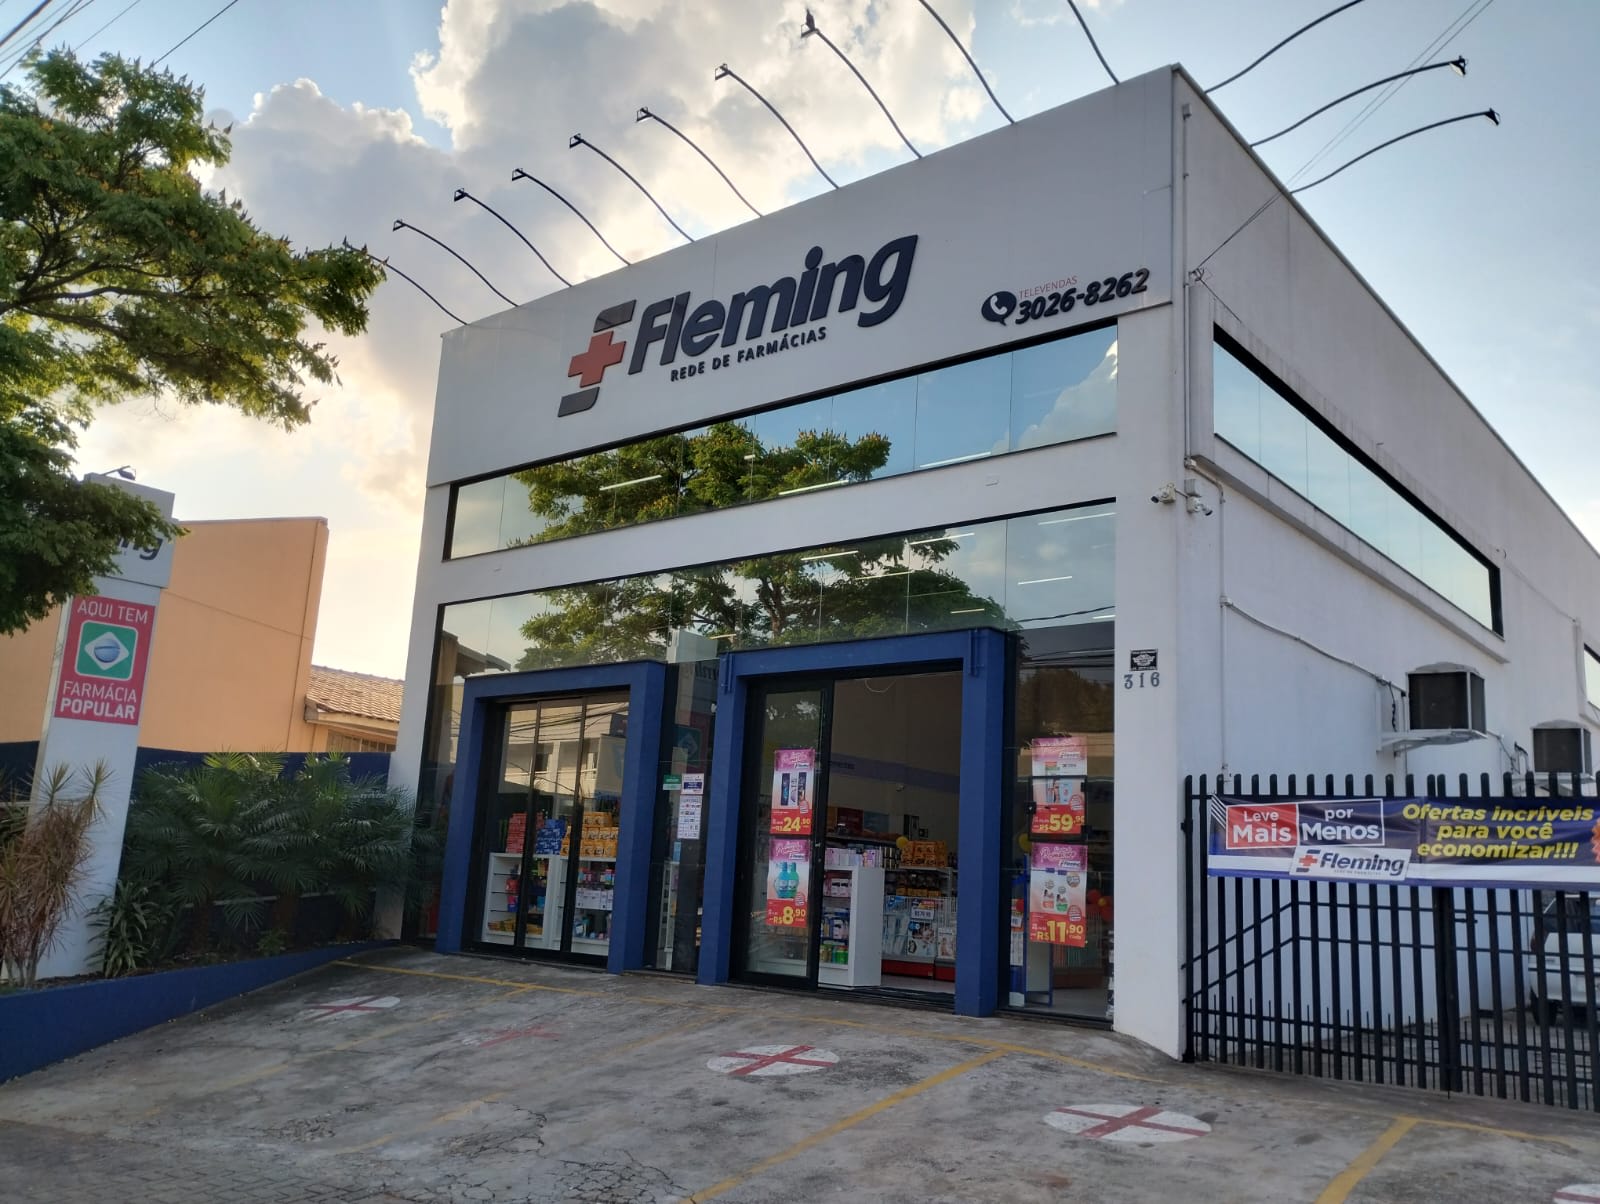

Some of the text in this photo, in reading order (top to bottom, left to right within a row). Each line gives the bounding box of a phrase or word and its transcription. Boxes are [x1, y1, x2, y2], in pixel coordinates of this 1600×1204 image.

[1015, 267, 1150, 325] 3026-8262
[1018, 275, 1078, 299] TELEVENDAS
[628, 235, 919, 376] Fleming
[670, 326, 827, 382] REDE DE FARMÁCIAS
[77, 599, 148, 624] AQUI TEM
[62, 680, 137, 703] FARMÁCIA
[60, 697, 136, 720] POPULAR
[1243, 810, 1280, 823] Leve
[1324, 808, 1354, 822] por
[1402, 804, 1594, 822] Ofertas incríveis
[1232, 823, 1292, 844] Mais
[1301, 822, 1380, 842] Menos
[1436, 822, 1554, 841] para você
[1417, 841, 1579, 860] economizar!!!
[1319, 852, 1405, 876] Fleming
